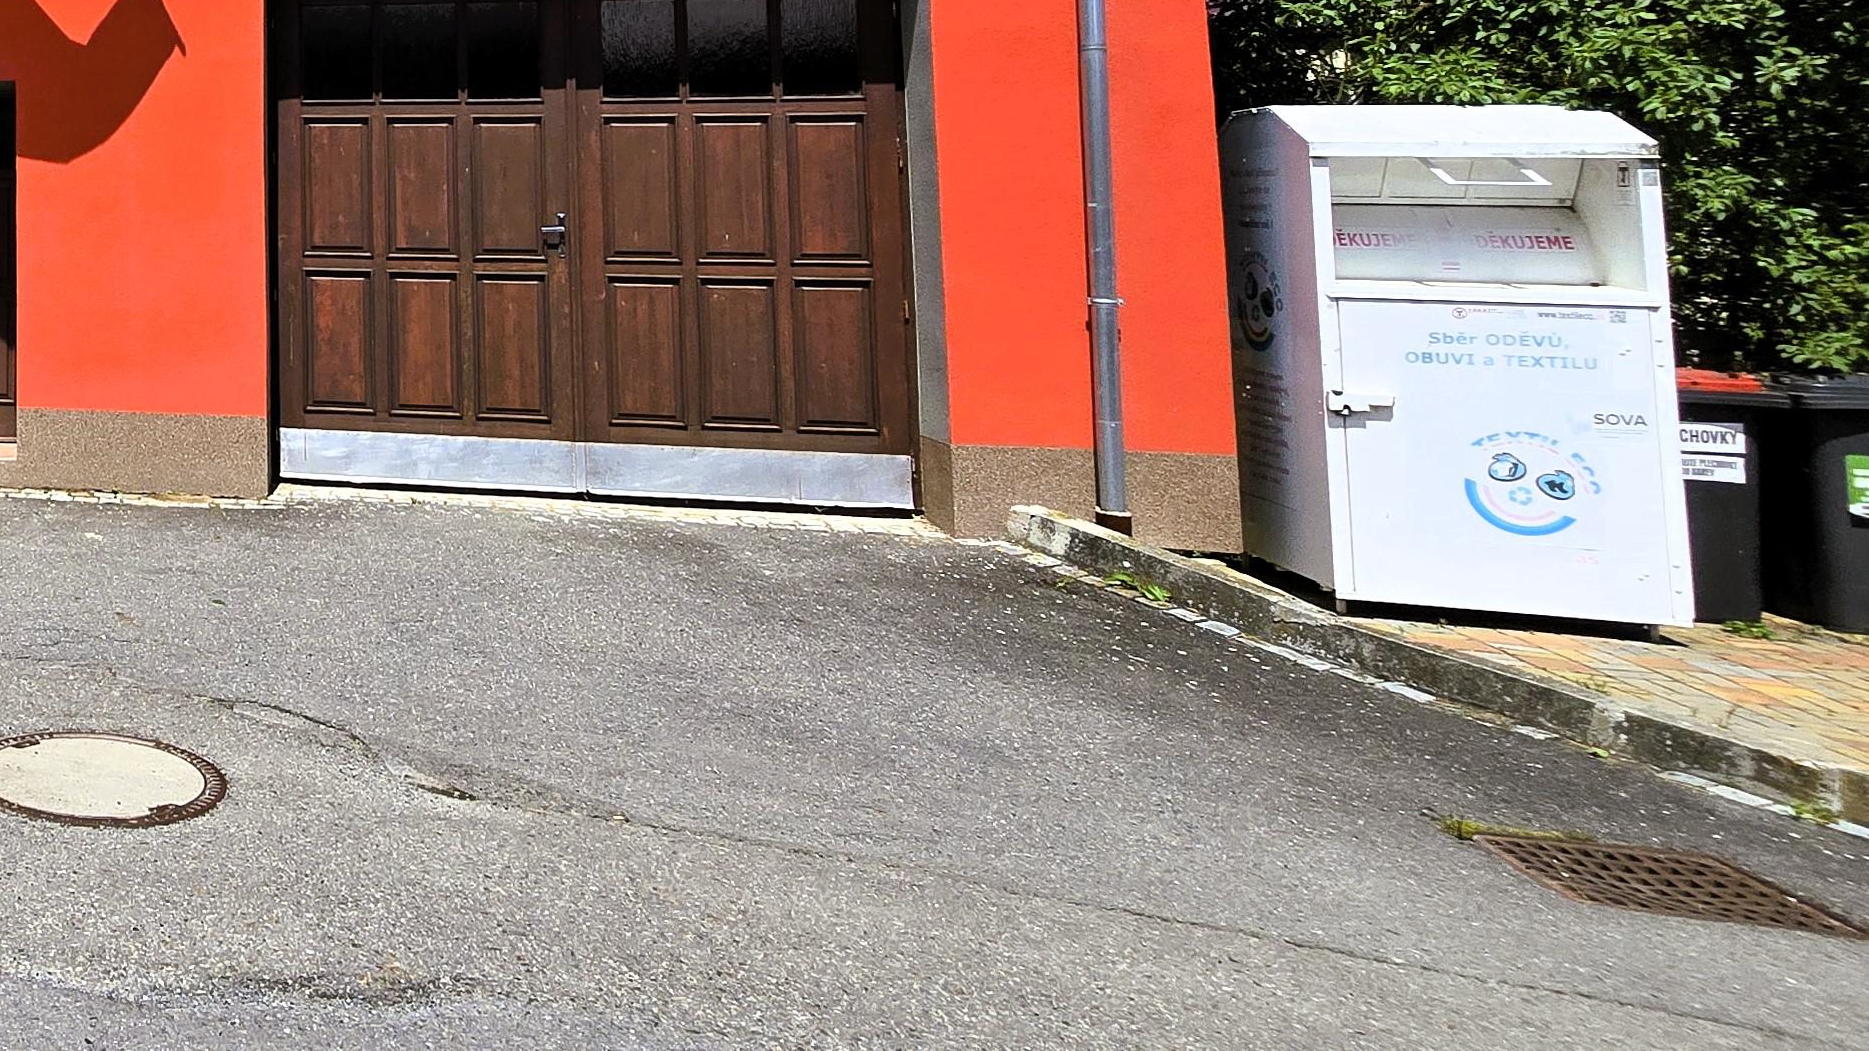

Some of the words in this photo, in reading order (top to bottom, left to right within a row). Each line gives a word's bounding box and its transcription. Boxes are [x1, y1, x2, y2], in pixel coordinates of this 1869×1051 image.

[1475, 231, 1575, 251] DĚKUJEME
[1428, 331, 1477, 345] Sběr
[1405, 351, 1475, 366] OBUVI
[1483, 356, 1495, 366] a
[1503, 354, 1598, 370] TEXTILU
[1593, 413, 1648, 426] SOVA
